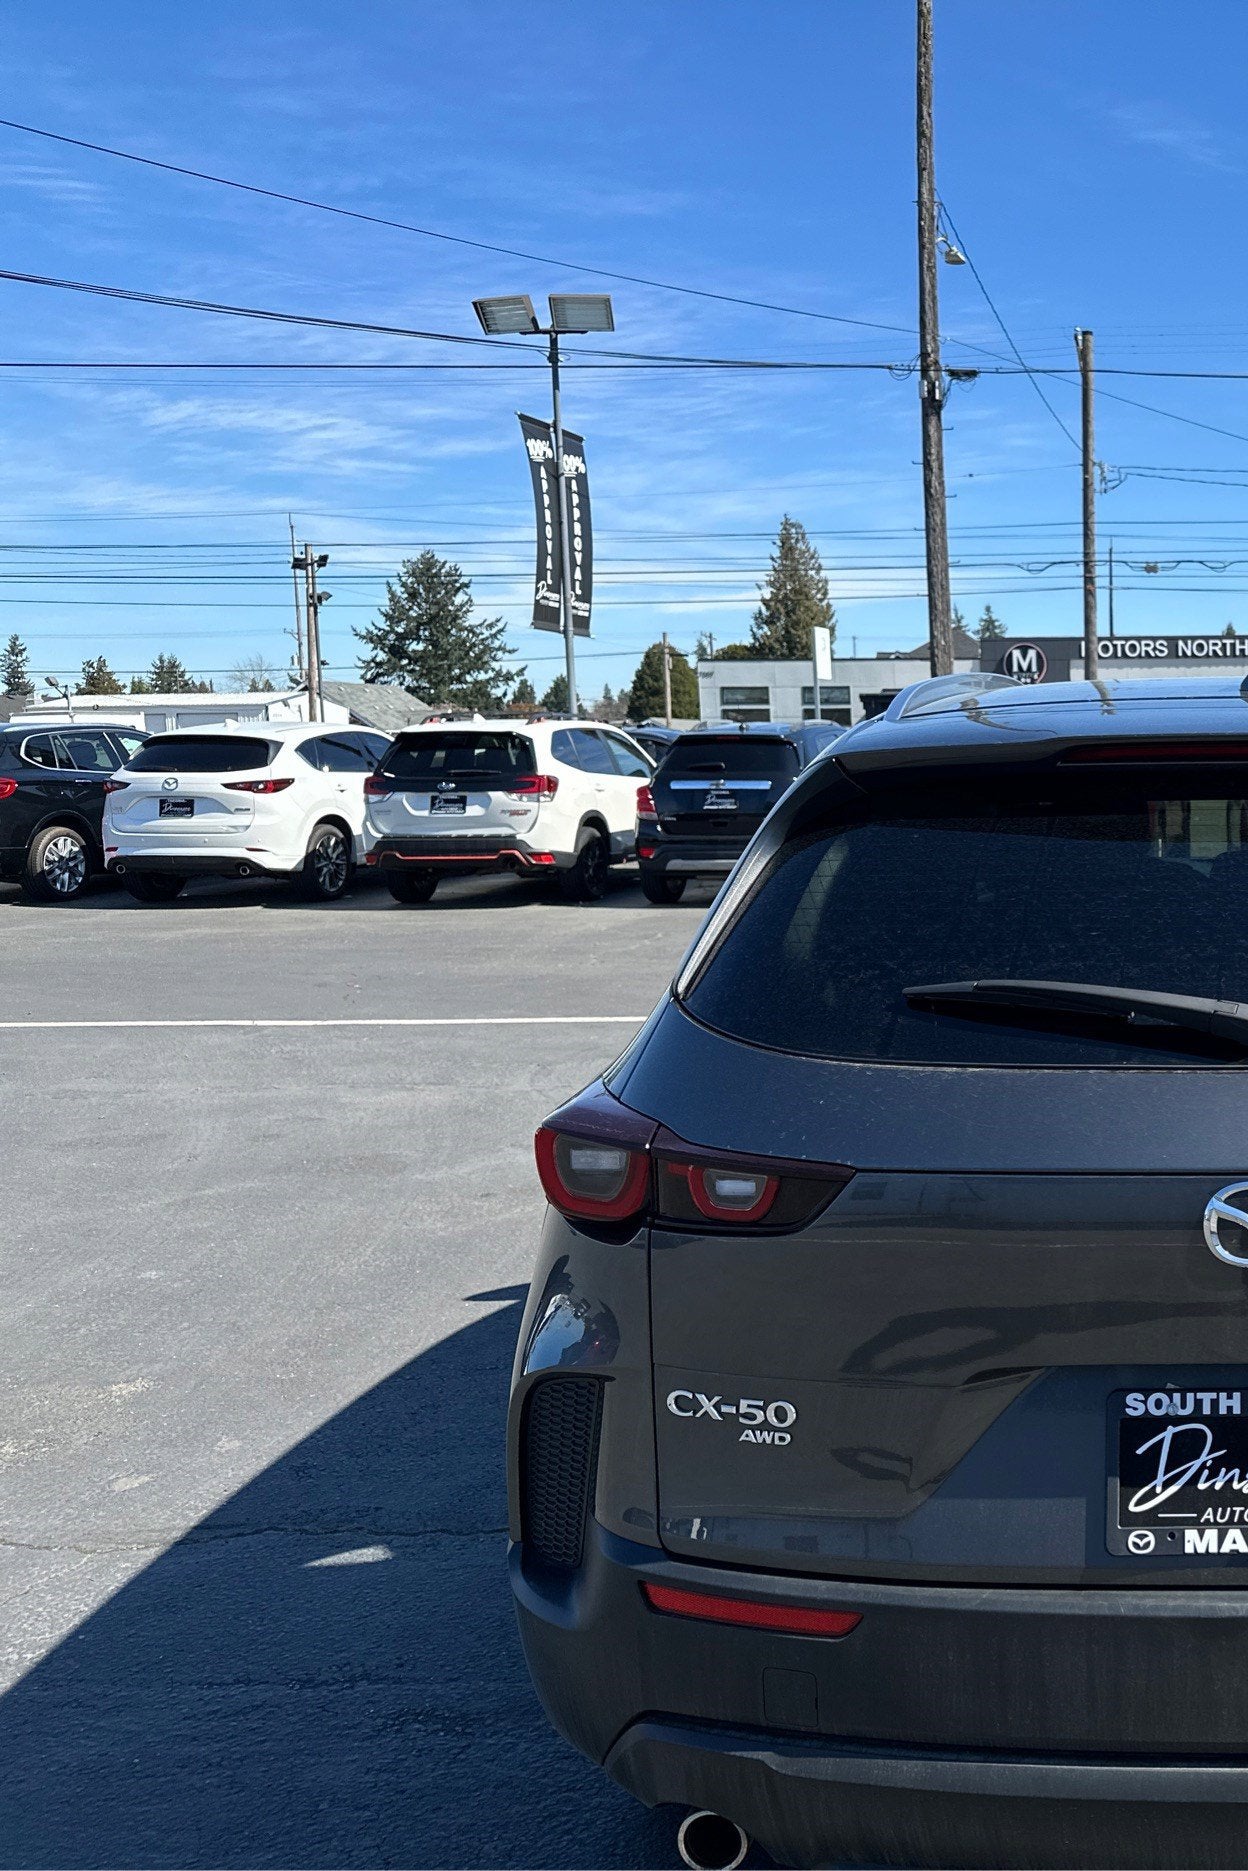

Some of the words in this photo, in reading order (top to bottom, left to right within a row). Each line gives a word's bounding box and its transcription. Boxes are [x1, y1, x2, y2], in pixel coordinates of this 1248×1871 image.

[563, 454, 586, 474] 00%
[540, 465, 552, 585] APPROVAL
[571, 479, 583, 595] APPROVAL
[1012, 649, 1037, 672] M
[667, 1390, 797, 1428] CX-50
[1125, 1392, 1241, 1416] SOUTH
[739, 1429, 791, 1446] AWD
